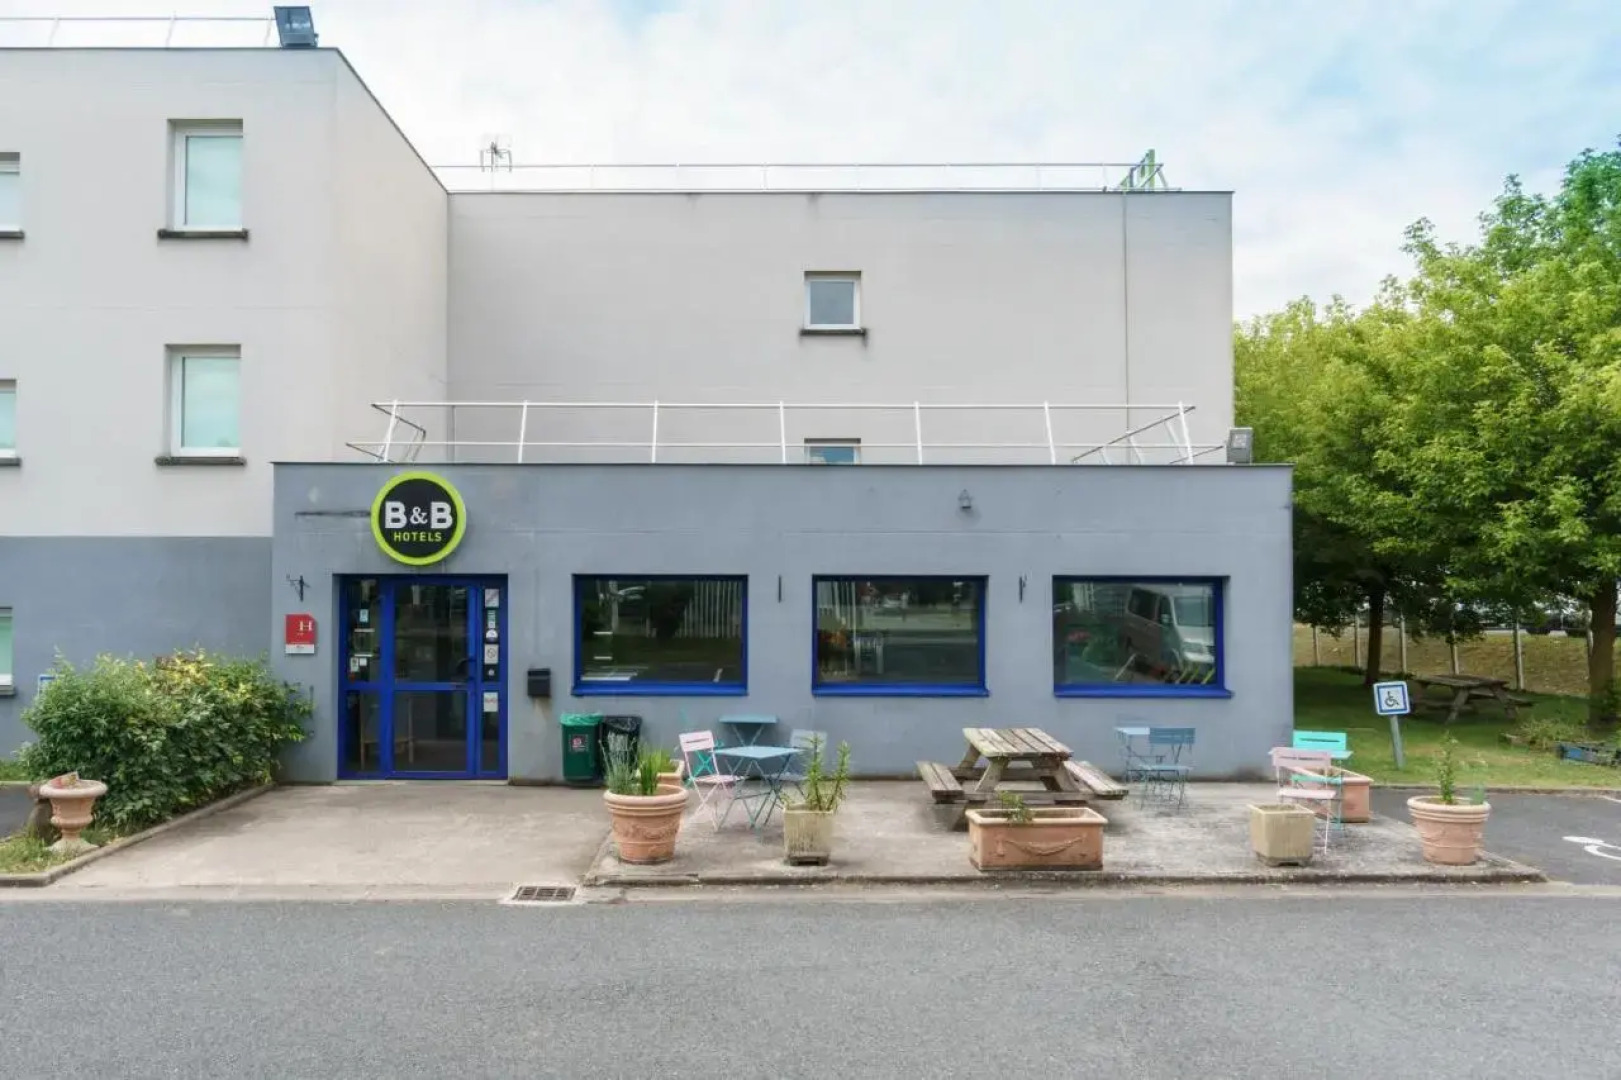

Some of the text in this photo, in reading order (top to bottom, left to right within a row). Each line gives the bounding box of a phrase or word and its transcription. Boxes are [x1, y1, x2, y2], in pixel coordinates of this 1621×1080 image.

[384, 501, 453, 529] B&B
[393, 532, 442, 542] HOTELS
[299, 620, 313, 632] H
